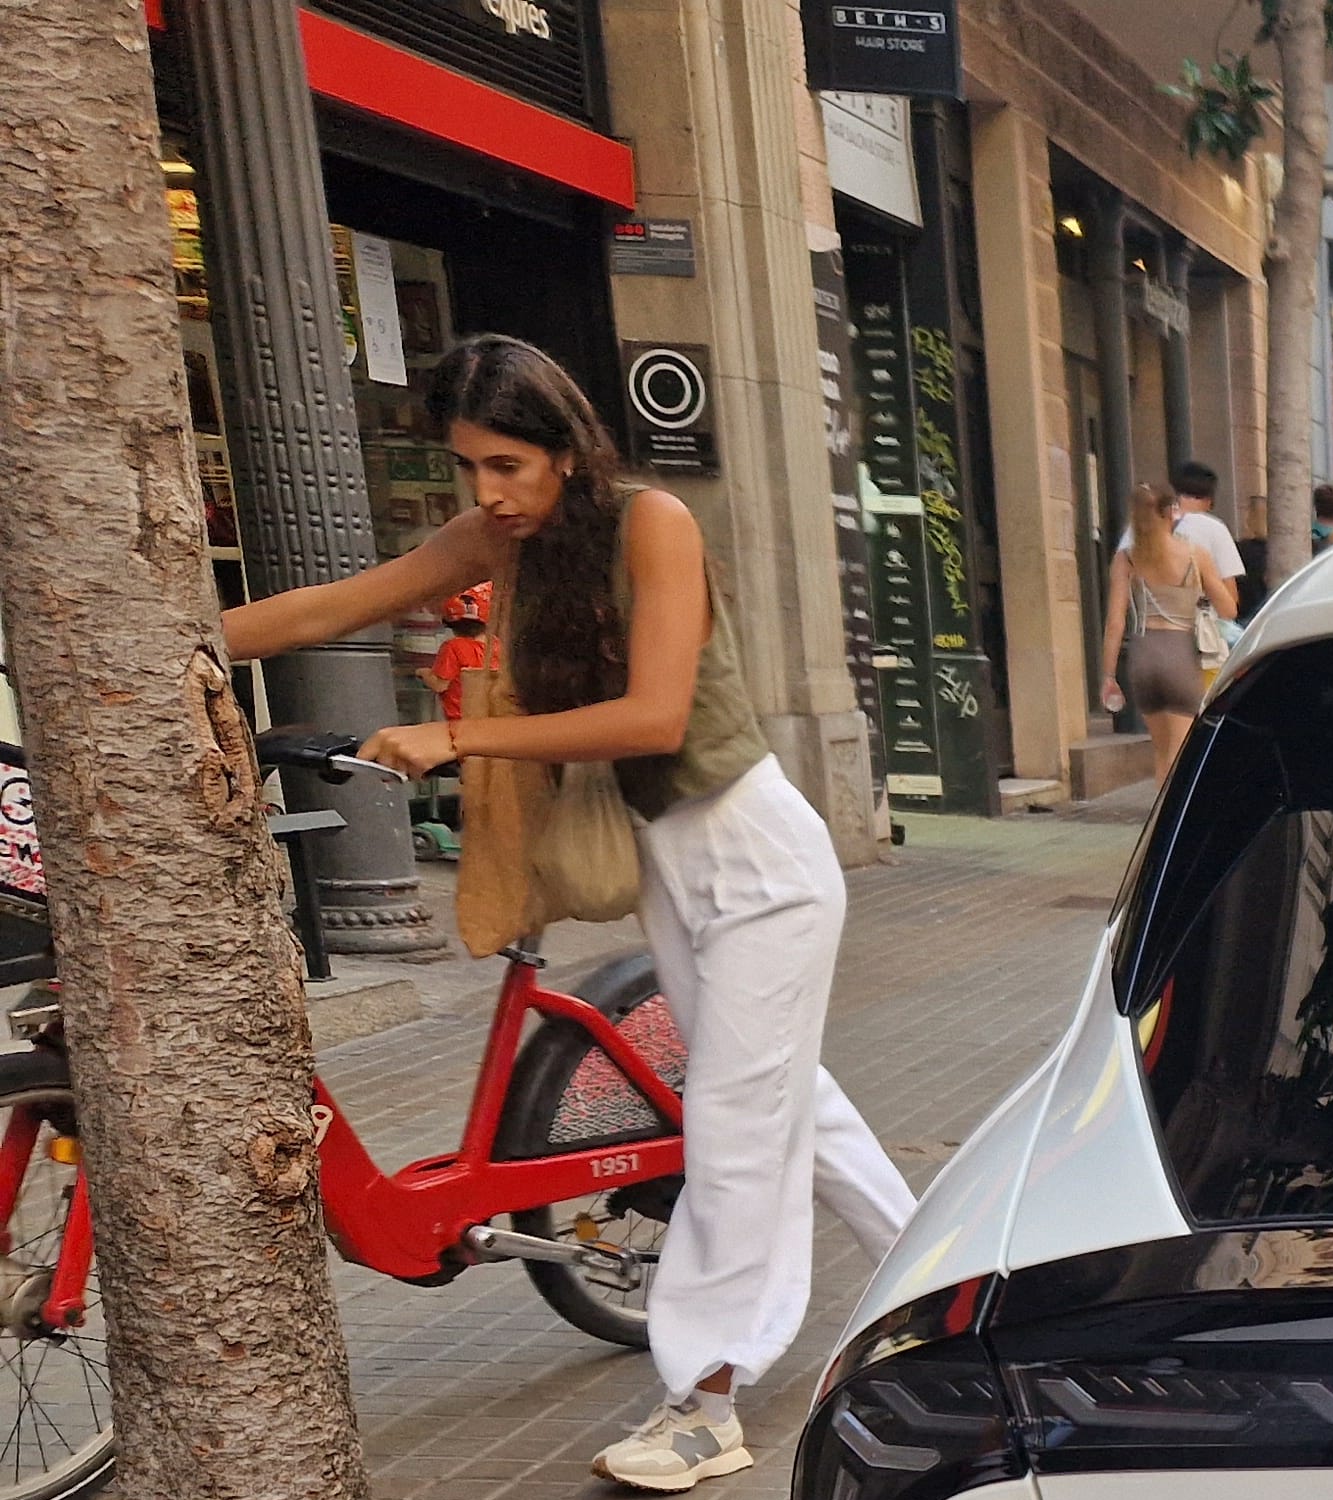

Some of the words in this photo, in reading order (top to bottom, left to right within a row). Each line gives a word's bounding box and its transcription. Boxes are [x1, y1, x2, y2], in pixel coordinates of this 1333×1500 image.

[855, 36, 885, 48] HAIR
[887, 37, 925, 52] STORE
[589, 1153, 640, 1178] 1951
